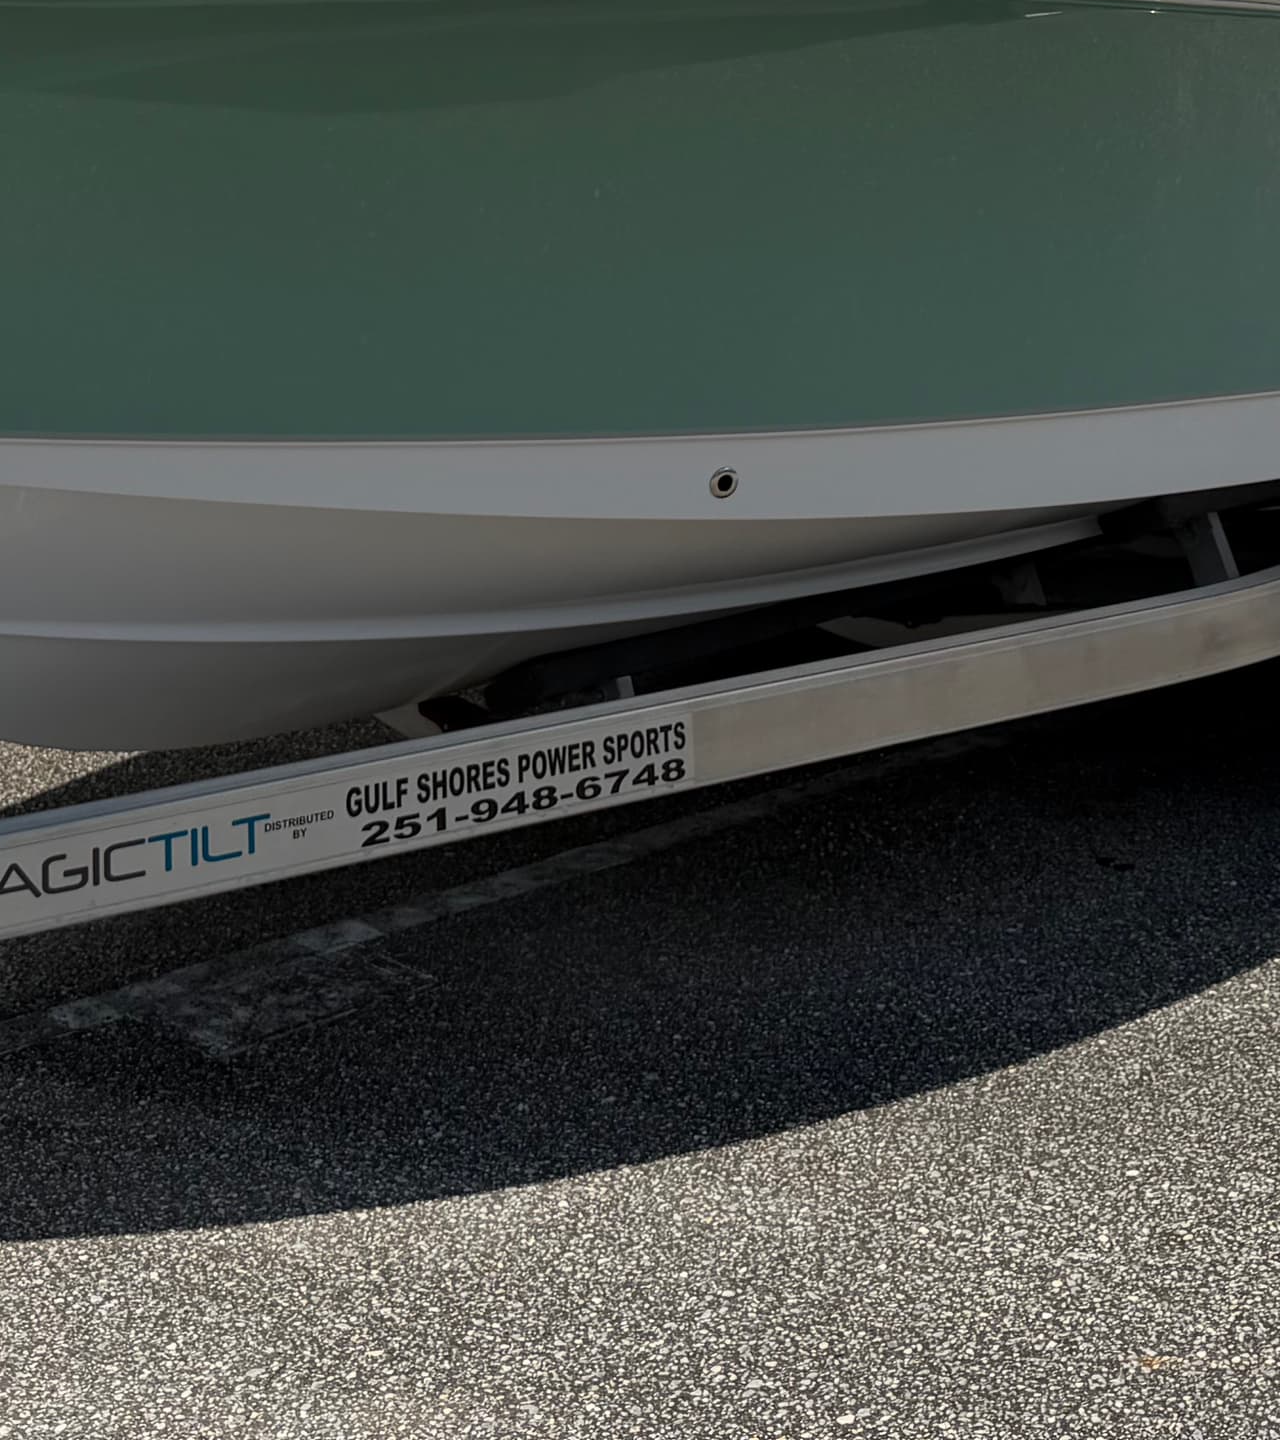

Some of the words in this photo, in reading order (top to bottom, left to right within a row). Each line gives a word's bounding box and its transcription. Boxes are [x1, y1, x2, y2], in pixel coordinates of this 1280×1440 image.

[346, 777, 409, 817] GULF
[417, 759, 510, 812] SHORES
[517, 739, 596, 783] POWER
[603, 722, 686, 764] SPORTS
[264, 809, 335, 833] DISTRIBUTED
[361, 758, 686, 848] 251-948-6748
[293, 828, 308, 840] BY
